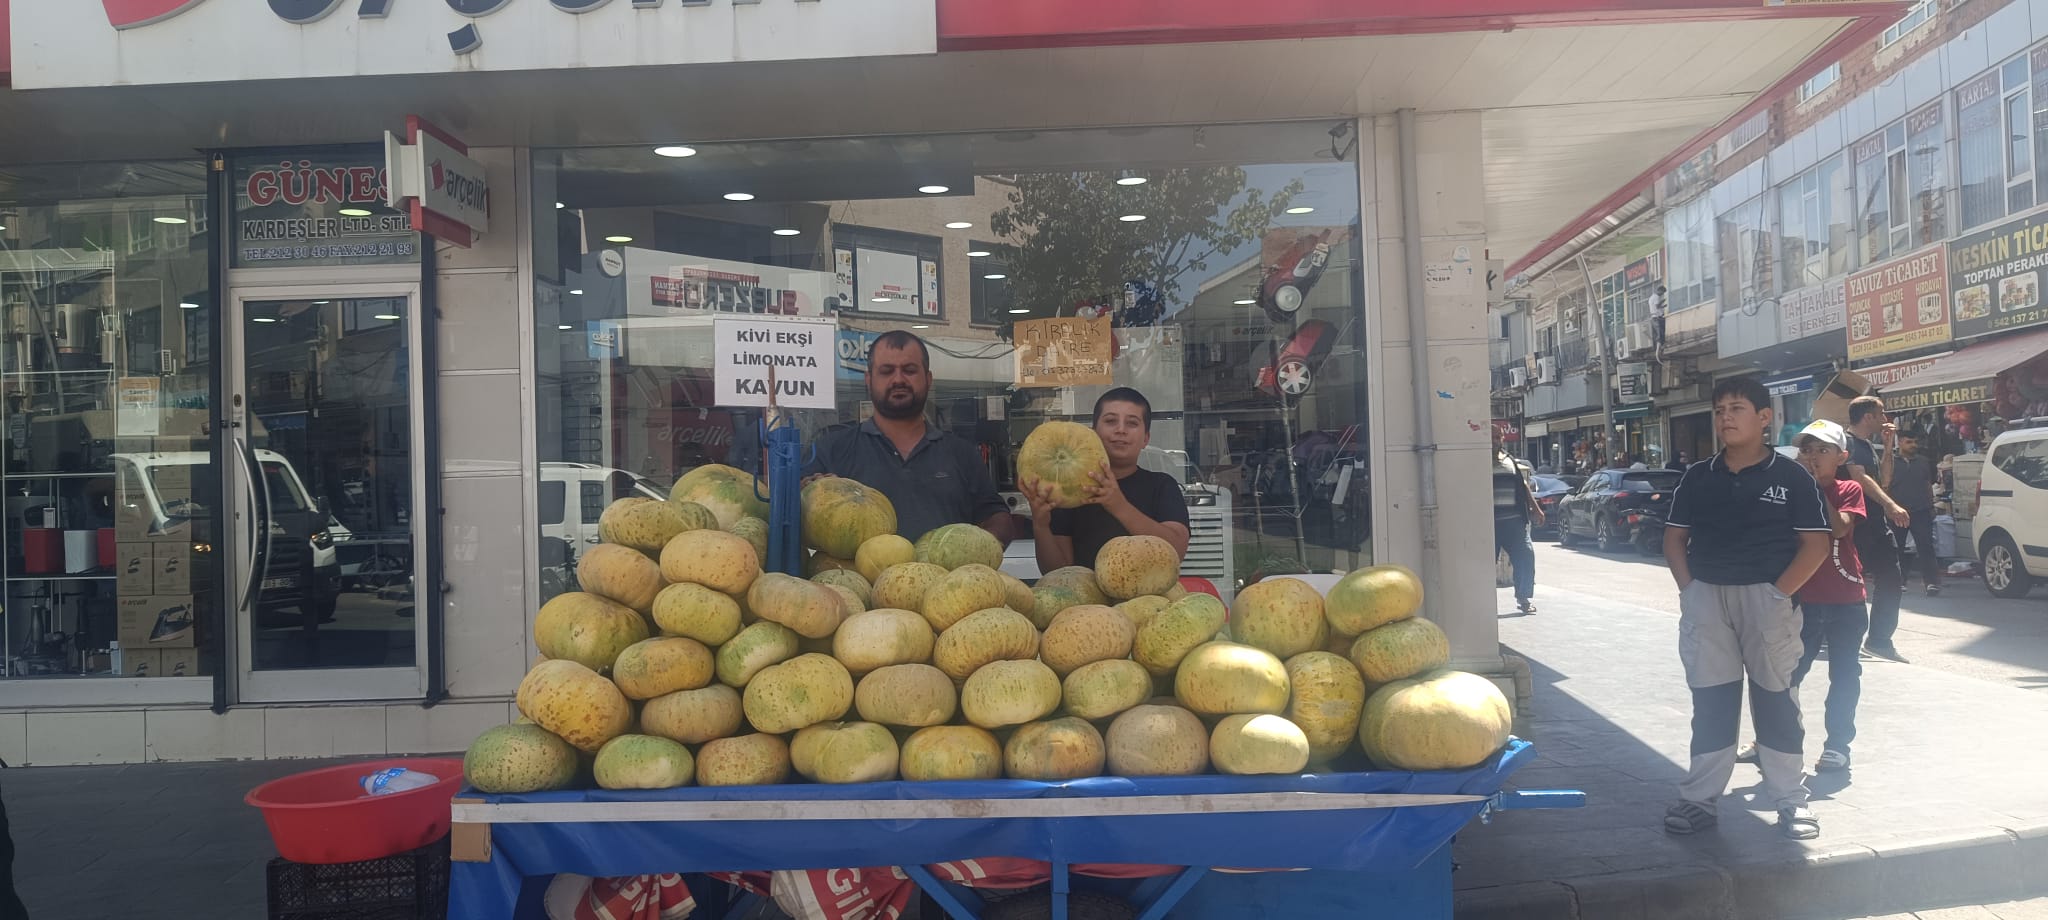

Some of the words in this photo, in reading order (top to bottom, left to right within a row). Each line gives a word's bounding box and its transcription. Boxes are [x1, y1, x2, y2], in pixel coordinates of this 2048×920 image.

[242, 217, 339, 243] KARDEŞLER
[341, 216, 376, 232] LTD.
[396, 242, 413, 255] 93
[1951, 231, 2010, 274] KESKİN
[1849, 271, 1883, 298] YAVUZ
[1964, 264, 2004, 285] TOPTAN
[1782, 285, 1845, 319] TAHTAKALE
[2028, 310, 2039, 321] 21
[737, 328, 770, 343] KİVİ
[776, 331, 813, 348] EKŞİ
[733, 351, 818, 368] LİMONATA
[1886, 389, 1929, 410] KESKİN
[1931, 385, 1987, 404] TİCARET
